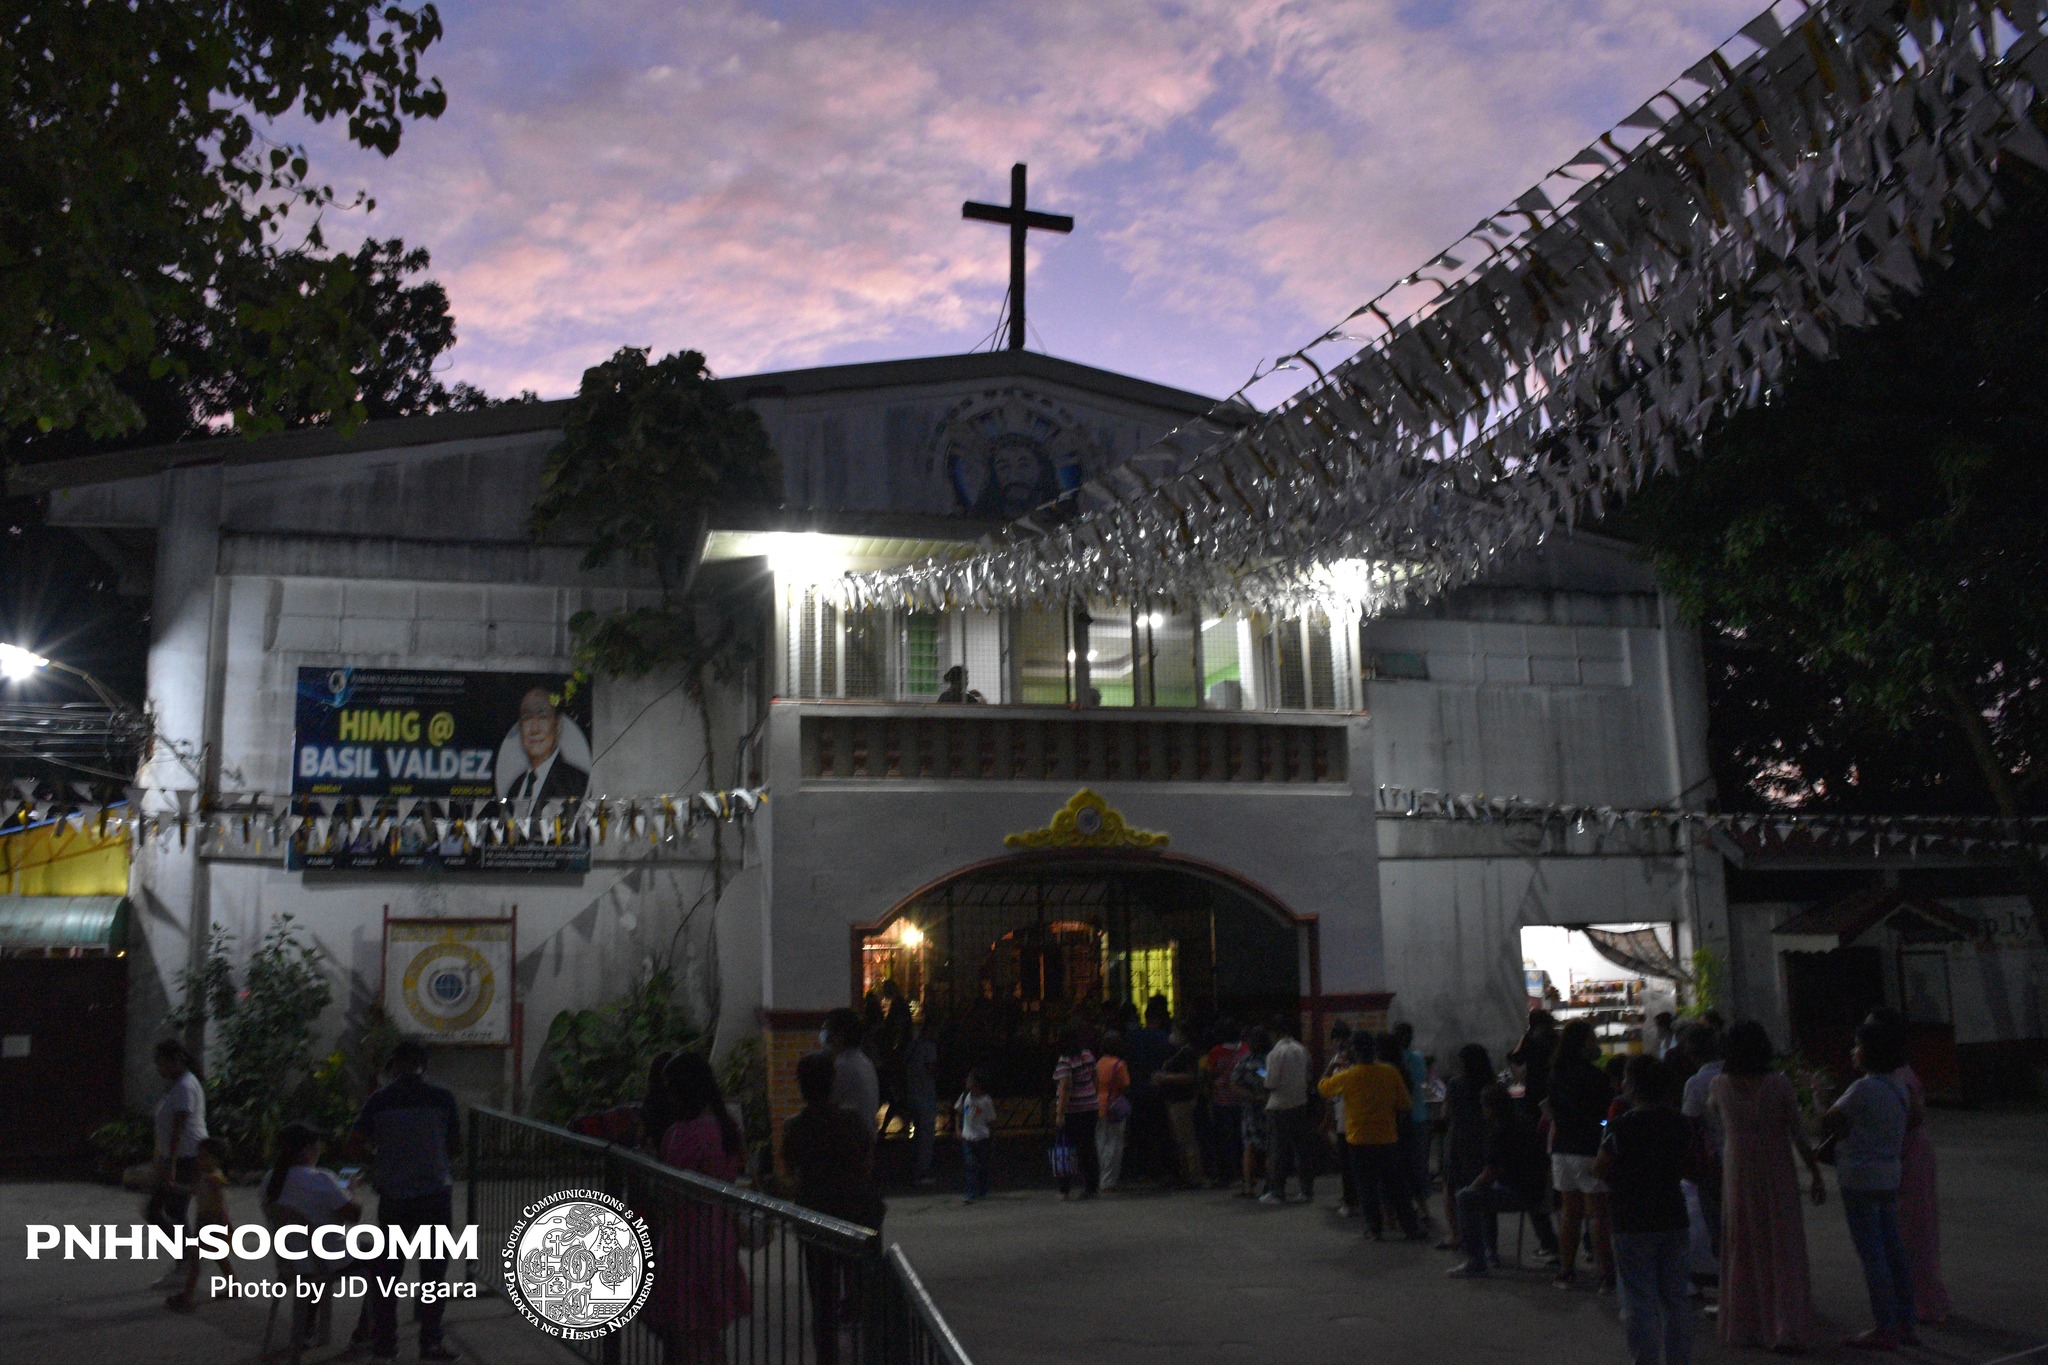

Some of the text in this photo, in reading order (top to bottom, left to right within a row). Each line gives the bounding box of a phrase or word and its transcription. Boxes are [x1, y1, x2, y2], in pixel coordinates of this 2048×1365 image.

[339, 709, 455, 747] HIMIG @
[299, 746, 494, 781] BASIL VALDEZ
